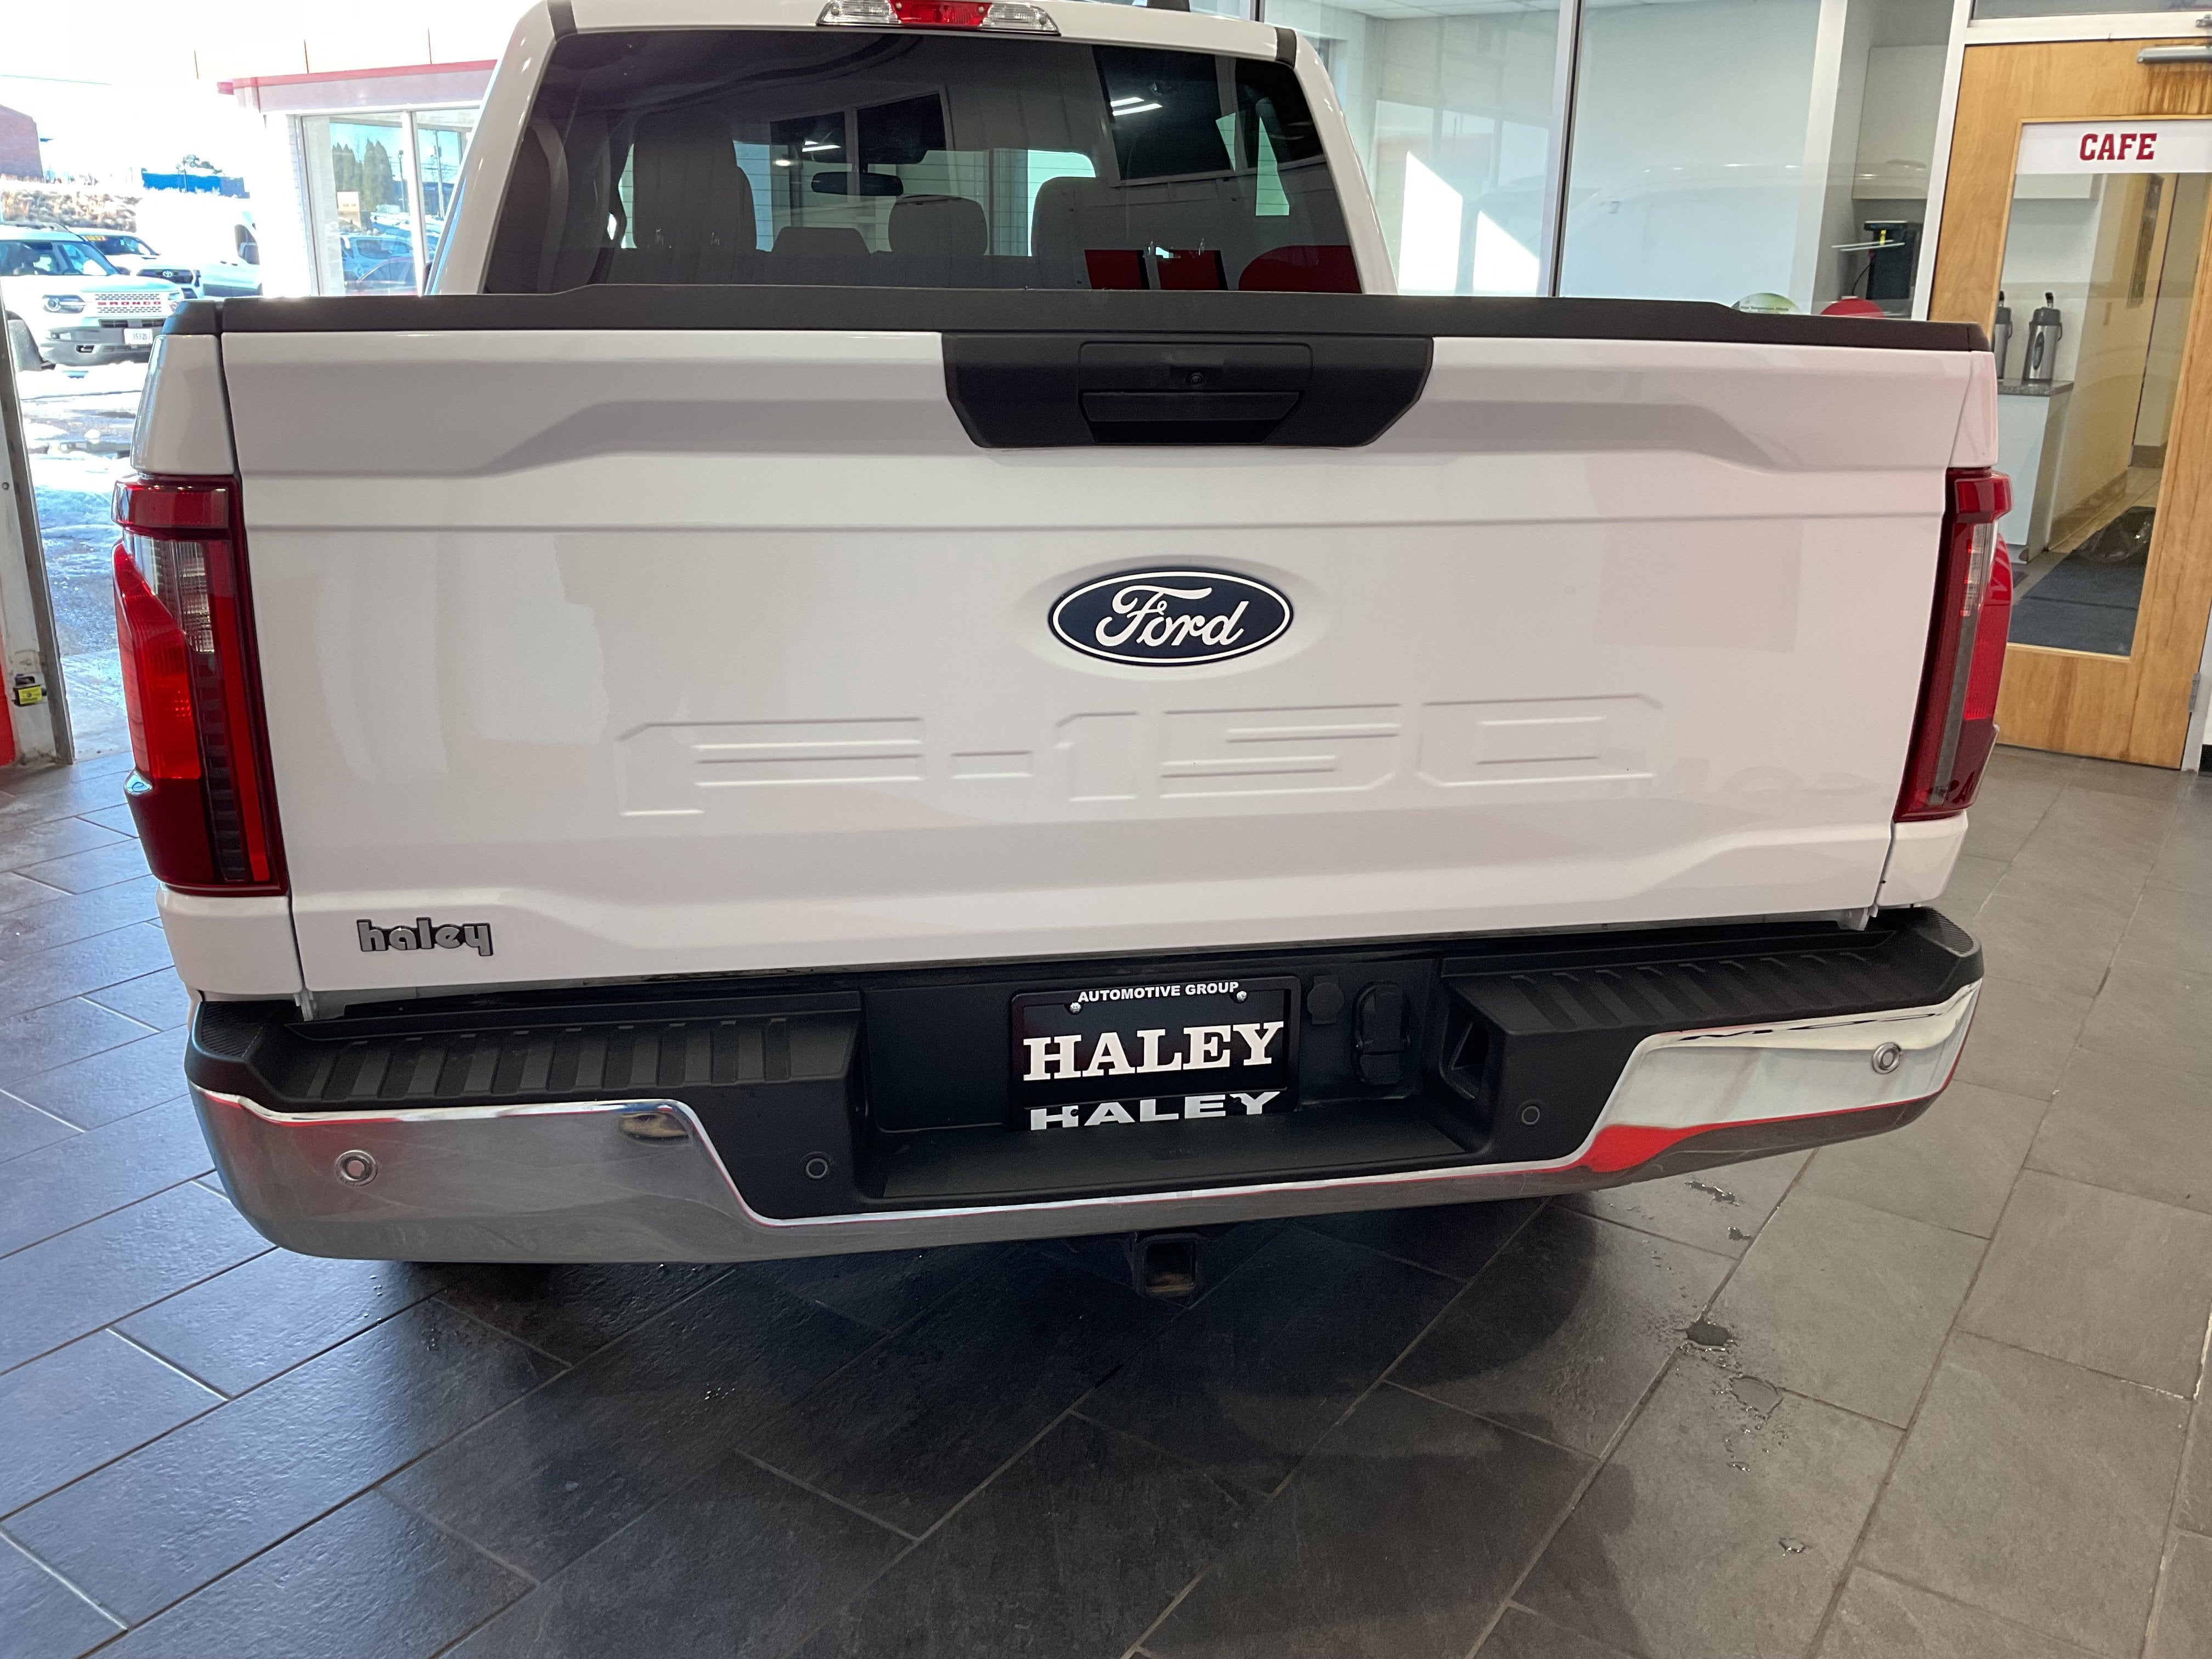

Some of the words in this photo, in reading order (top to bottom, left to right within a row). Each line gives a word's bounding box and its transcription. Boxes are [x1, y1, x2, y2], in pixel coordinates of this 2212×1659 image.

[2079, 133, 2157, 161] CAFE
[1095, 585, 1249, 647] Ford
[613, 693, 1663, 816] F-150
[356, 917, 493, 956] haley
[1077, 985, 1181, 1003] AUTOMOTIVE
[1185, 981, 1239, 995] GROUP
[1023, 1021, 1284, 1081] HALEY
[1030, 1091, 1281, 1131] HALEY
